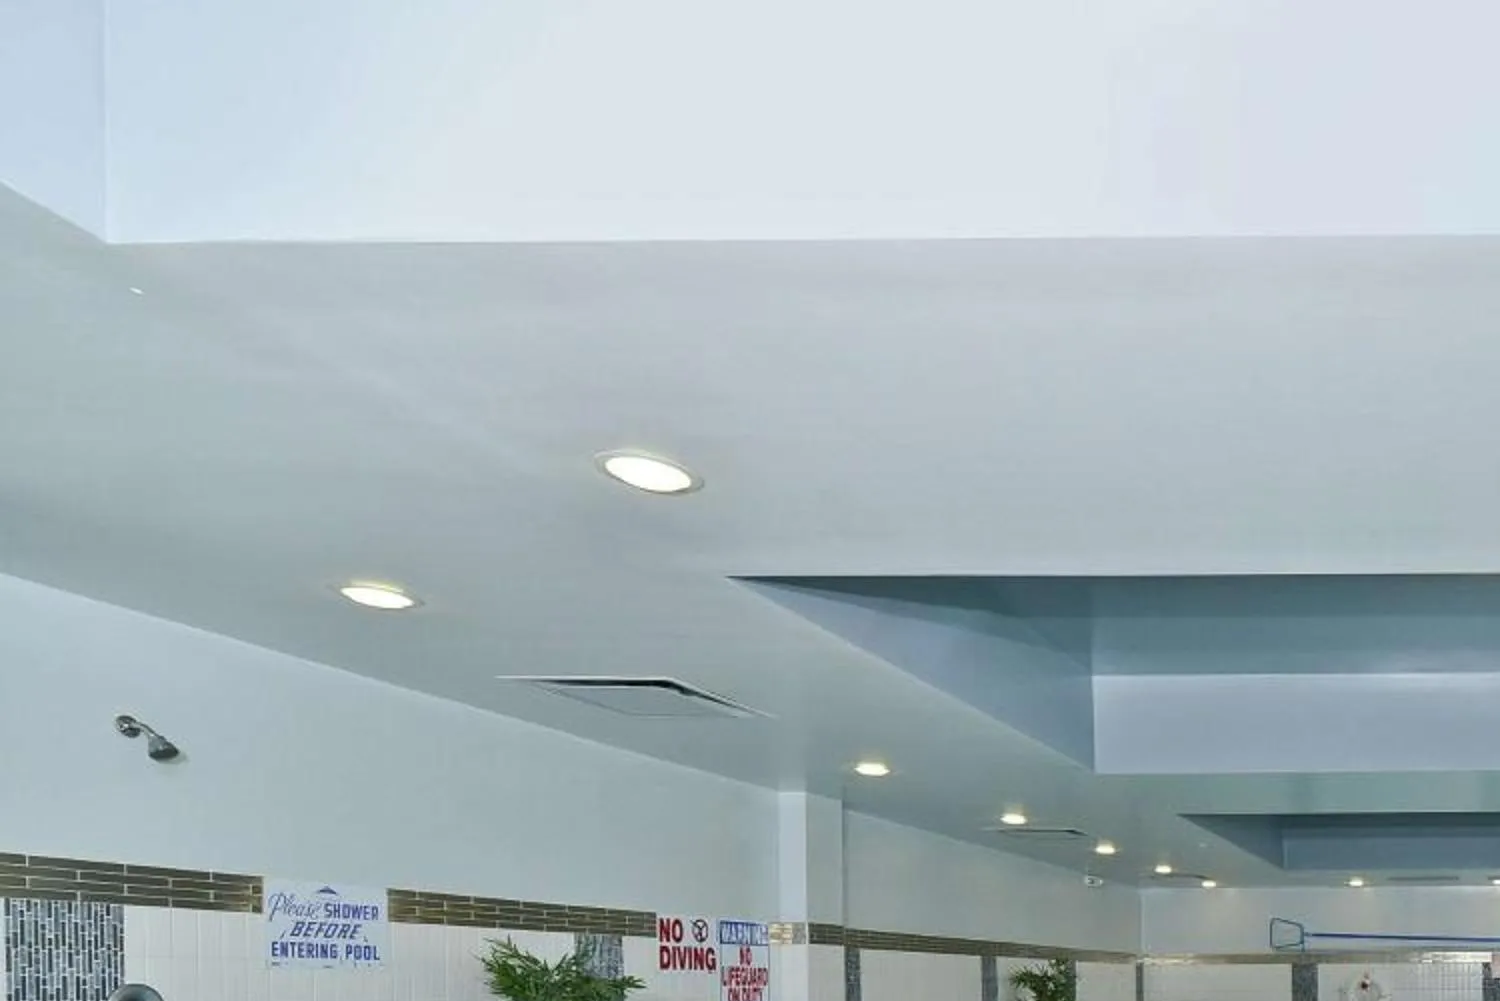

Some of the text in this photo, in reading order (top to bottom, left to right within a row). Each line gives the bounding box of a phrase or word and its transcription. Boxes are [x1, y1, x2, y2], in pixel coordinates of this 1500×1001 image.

[268, 891, 379, 922] Please SHOWER
[290, 921, 362, 939] BEFORE
[659, 918, 684, 943] NO
[271, 942, 381, 961] ENTERING POOL
[659, 945, 717, 971] DIVING
[739, 945, 752, 966] NO
[721, 967, 767, 987] LIFEGUARD
